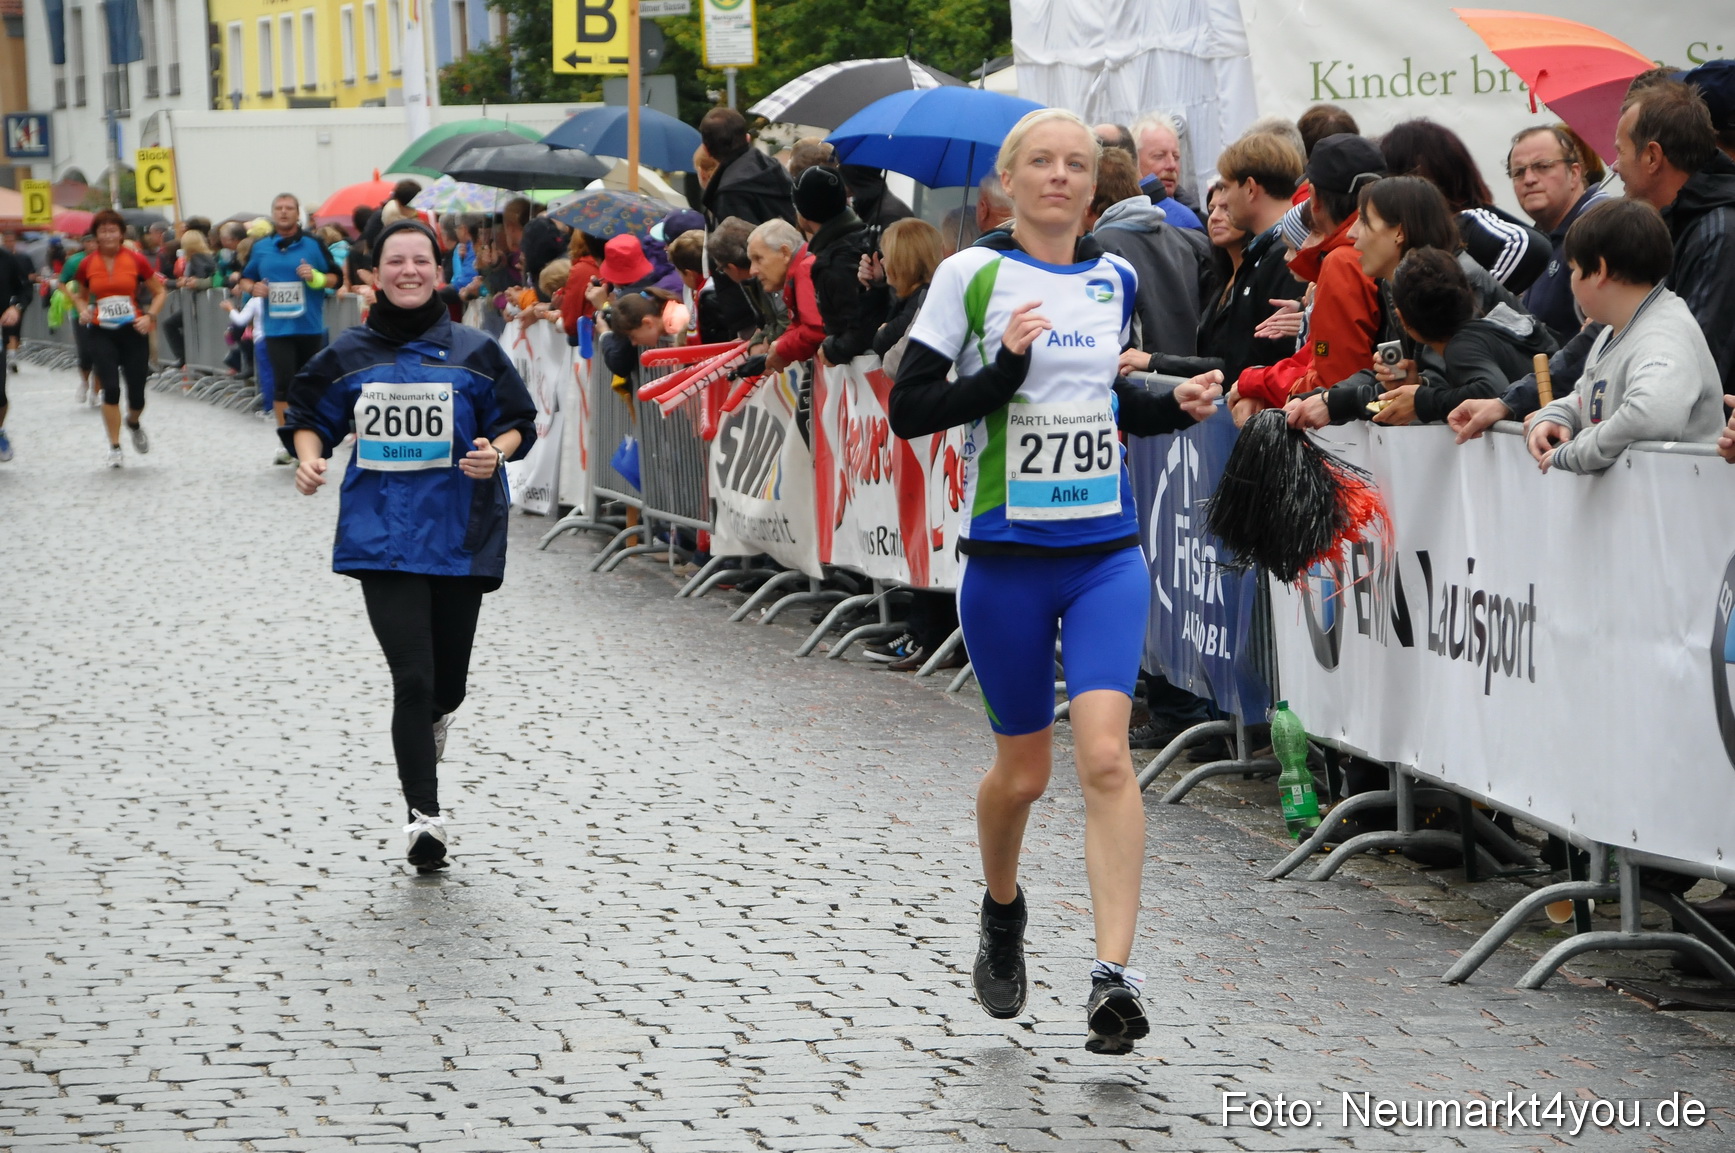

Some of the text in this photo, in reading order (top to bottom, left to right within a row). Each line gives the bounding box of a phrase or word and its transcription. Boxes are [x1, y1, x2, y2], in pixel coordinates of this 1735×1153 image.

[577, 0, 617, 42] B
[1309, 56, 1457, 101] Kinder
[145, 165, 165, 193] C
[29, 193, 45, 214] D
[270, 290, 300, 304] 2824
[1047, 330, 1096, 347] Anke
[389, 393, 435, 401] Neumarkt
[364, 405, 443, 437] 2606
[1010, 412, 1107, 426] PARTL Neumarkt
[383, 446, 422, 458] Selina
[1020, 428, 1113, 474] 2795
[1051, 486, 1089, 502] Anke
